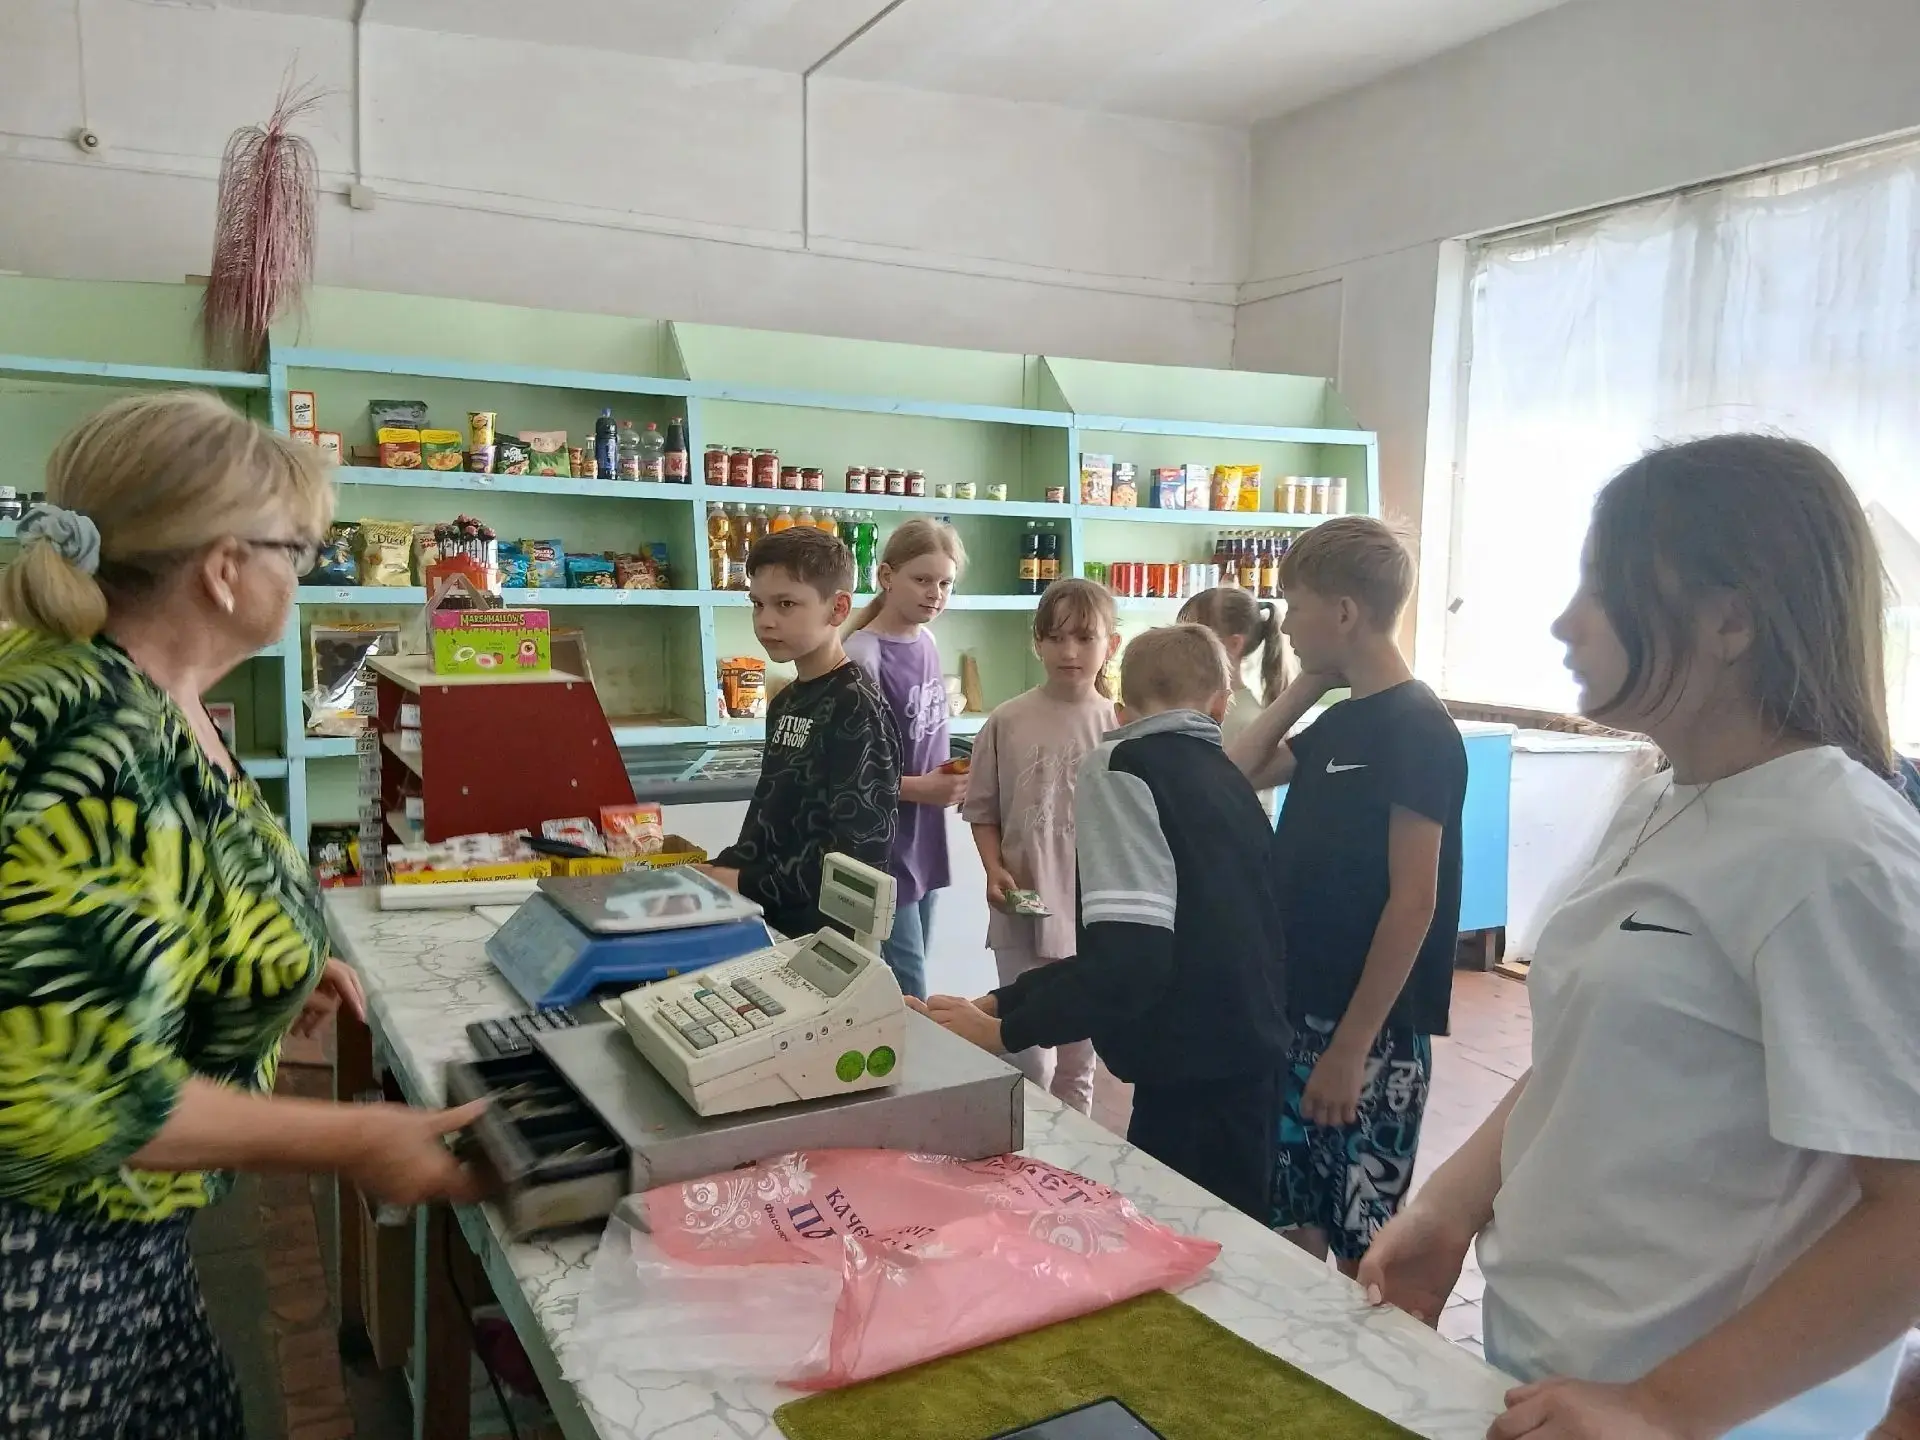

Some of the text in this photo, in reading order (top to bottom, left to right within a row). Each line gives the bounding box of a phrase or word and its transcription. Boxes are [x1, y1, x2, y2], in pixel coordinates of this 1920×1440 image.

[460, 613, 526, 627] MARSHMALLOWS
[776, 714, 813, 734] UTURE
[772, 730, 808, 749] IS NOW
